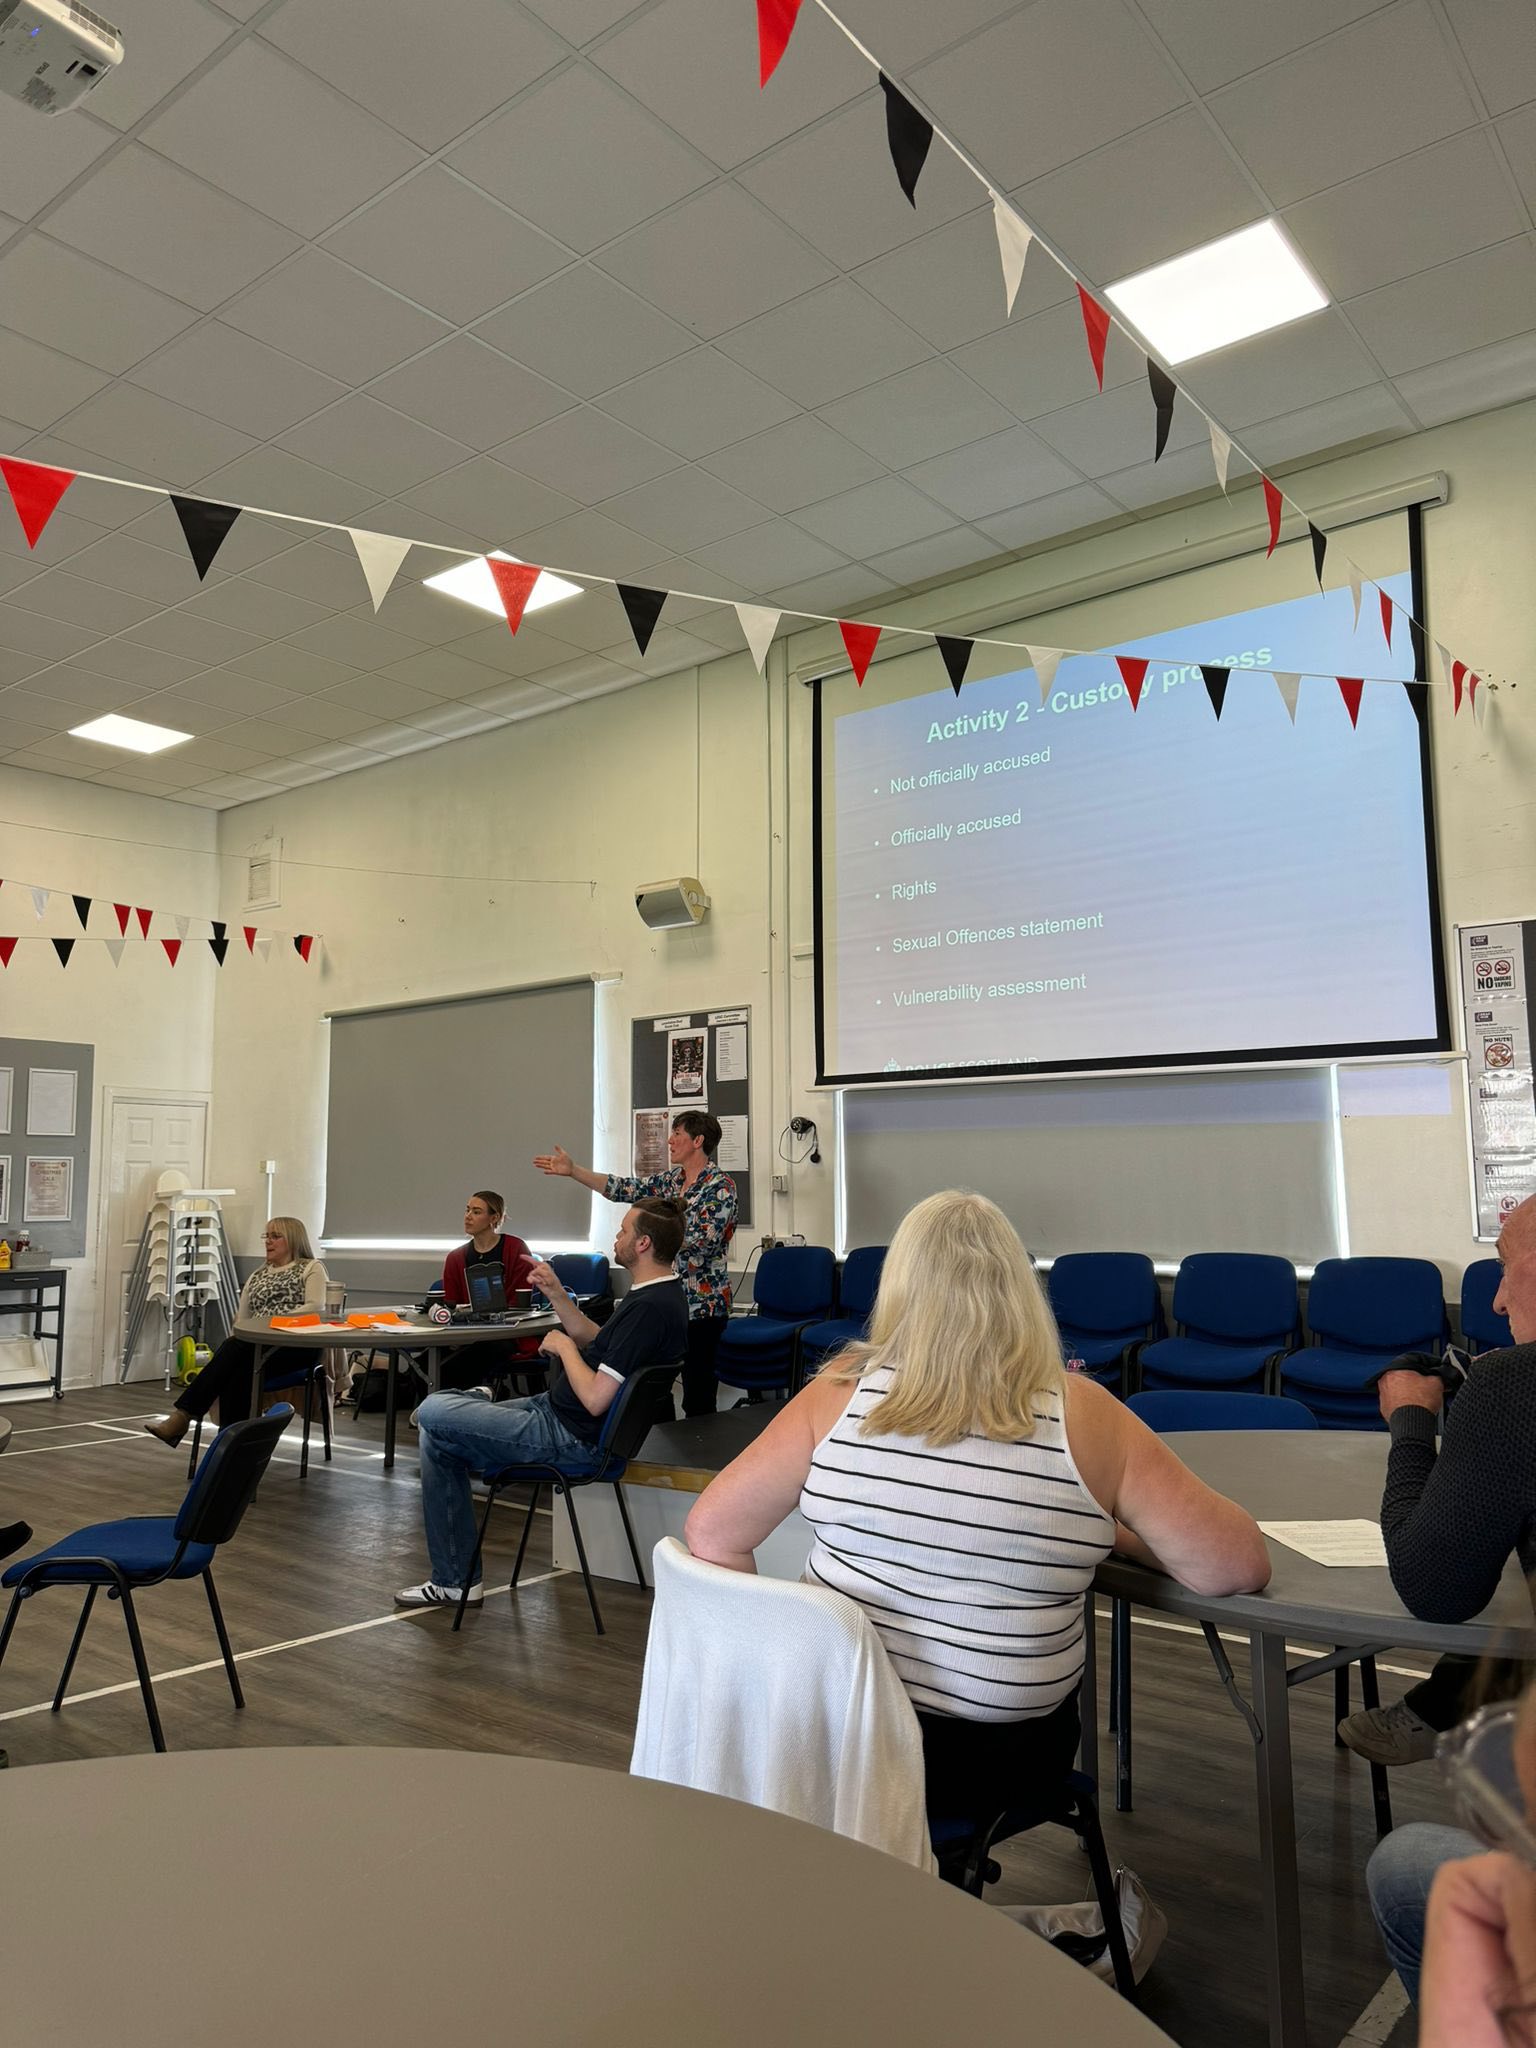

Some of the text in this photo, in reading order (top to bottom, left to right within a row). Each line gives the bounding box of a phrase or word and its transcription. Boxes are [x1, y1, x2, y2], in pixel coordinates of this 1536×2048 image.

[927, 708, 1009, 743] Activity
[1016, 701, 1029, 723] 2
[890, 746, 1051, 794] Not officially accused
[891, 808, 1022, 847] Officially accused
[892, 880, 937, 900] Rights
[893, 912, 1104, 953] Sexual Offences statement
[893, 973, 1087, 1007] Vulnerability assessment
[1477, 977, 1494, 989] NO
